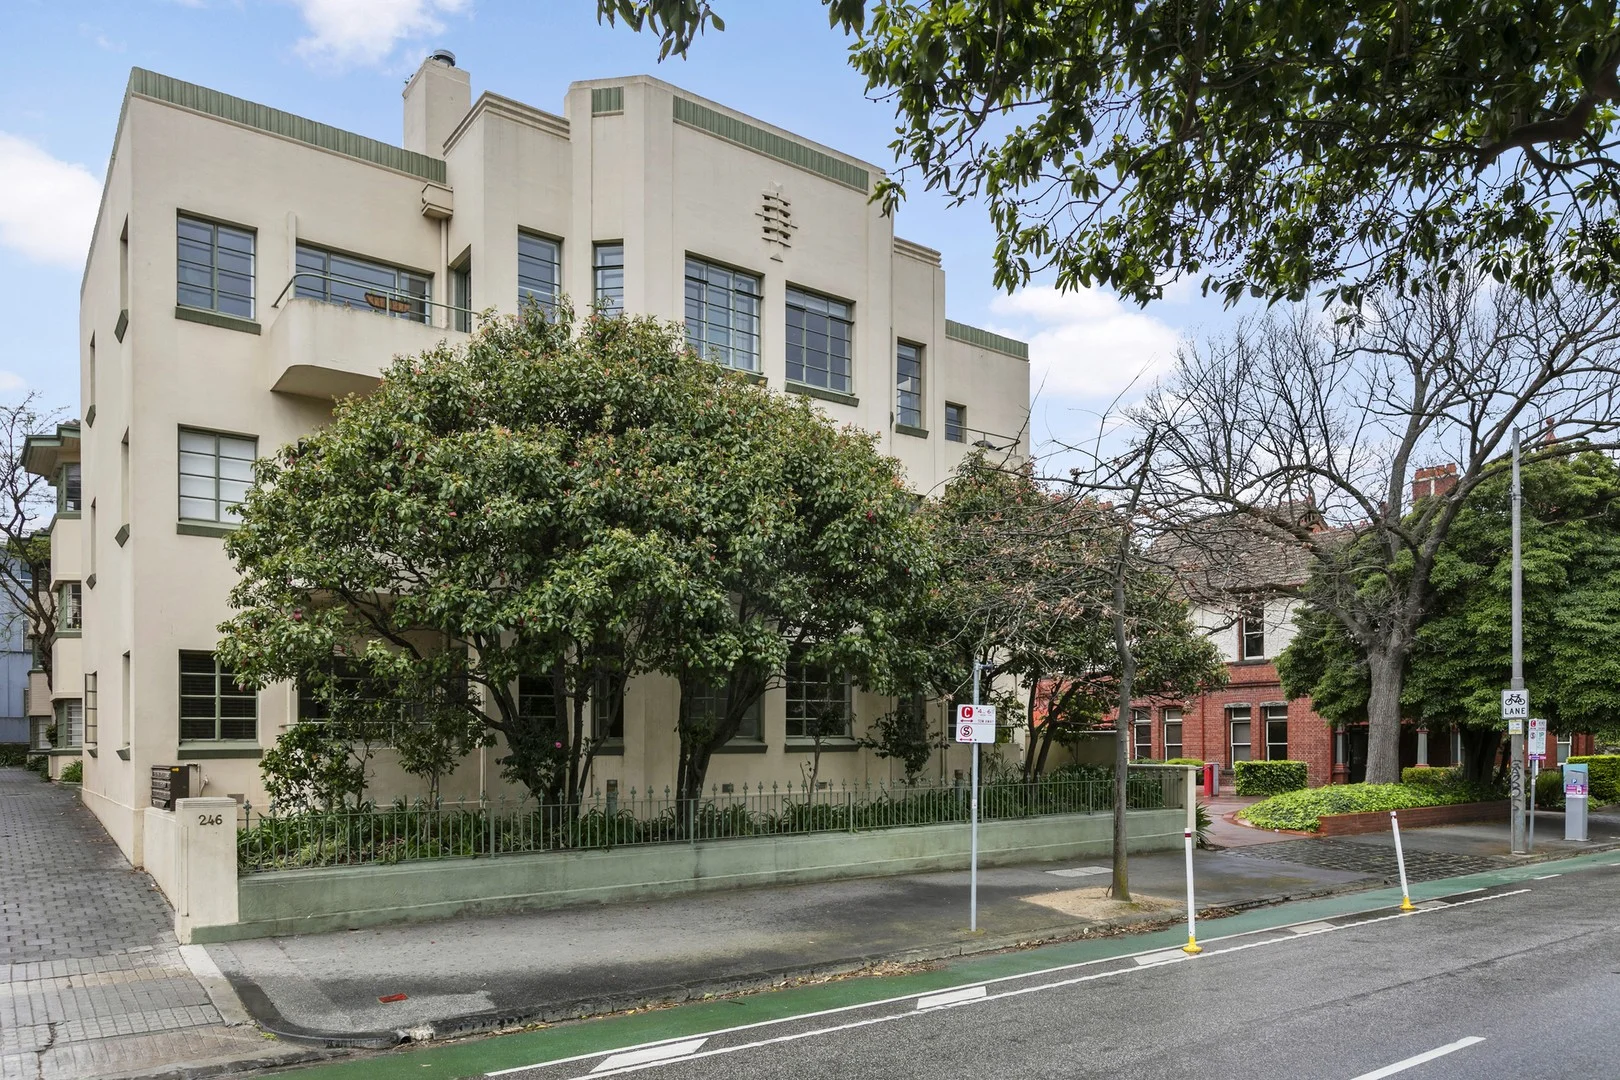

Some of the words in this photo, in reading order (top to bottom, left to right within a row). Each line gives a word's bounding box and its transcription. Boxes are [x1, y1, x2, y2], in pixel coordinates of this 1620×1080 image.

[964, 707, 971, 718] C
[963, 726, 970, 736] S
[198, 814, 223, 826] 246
